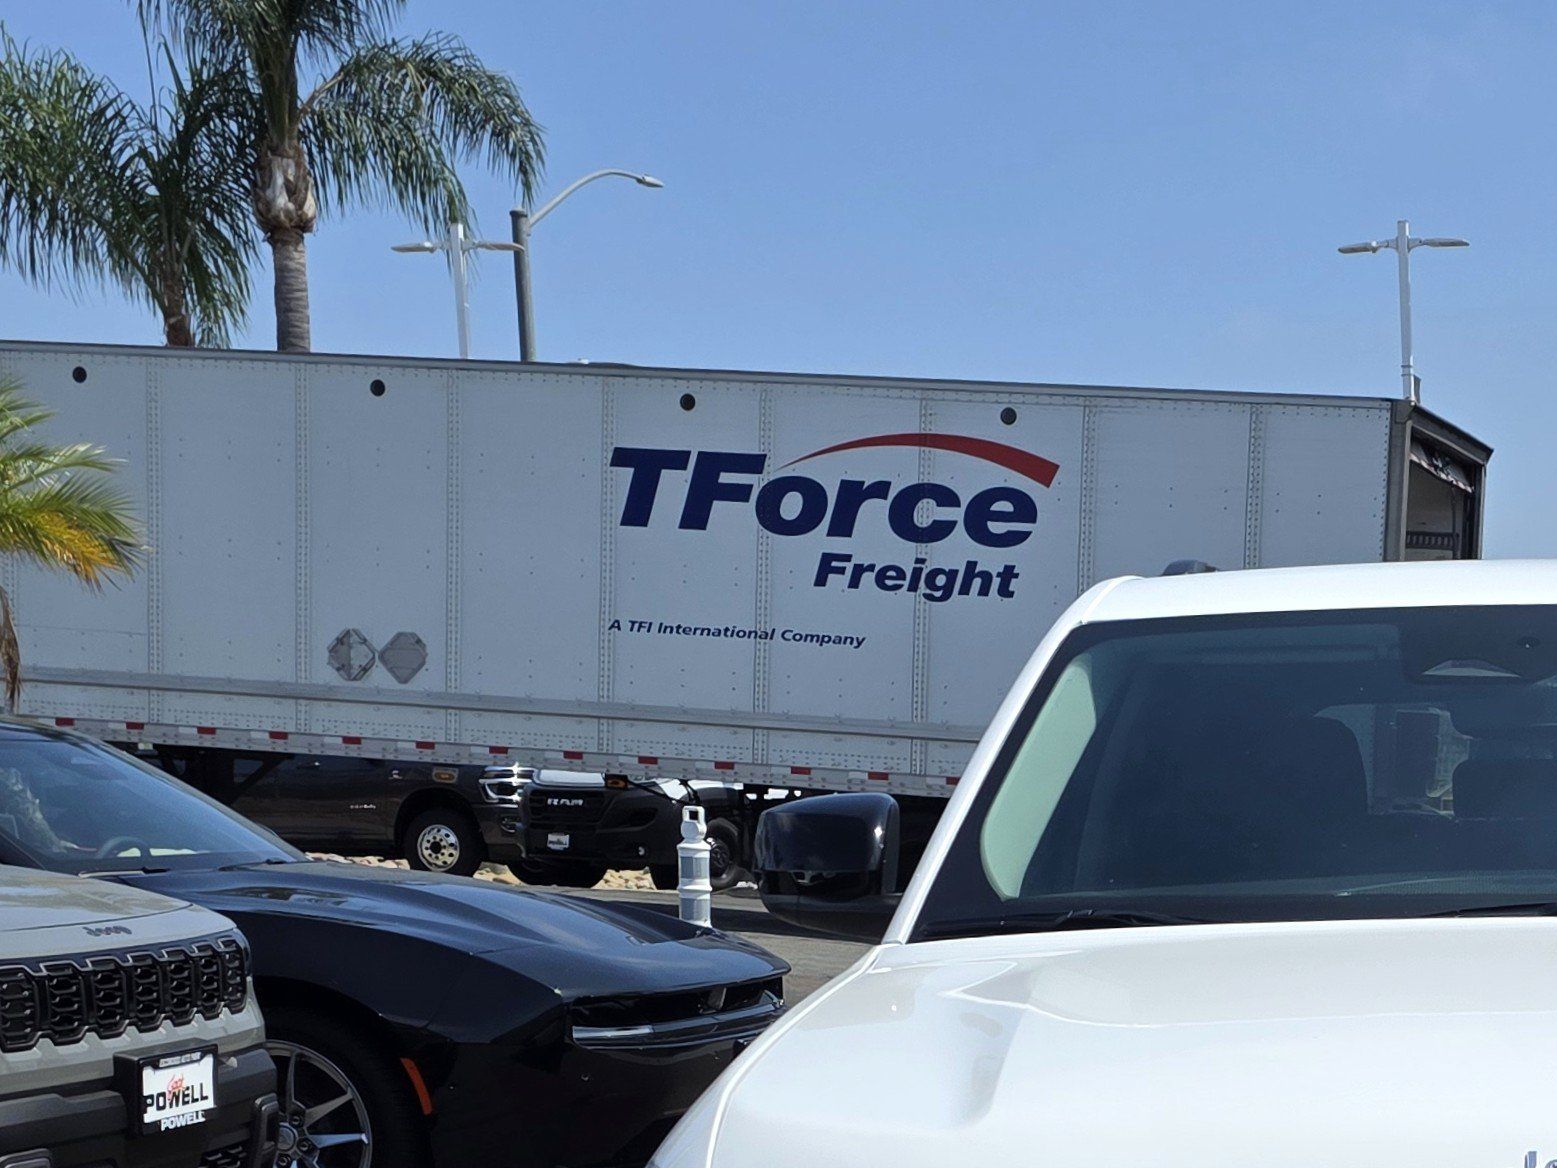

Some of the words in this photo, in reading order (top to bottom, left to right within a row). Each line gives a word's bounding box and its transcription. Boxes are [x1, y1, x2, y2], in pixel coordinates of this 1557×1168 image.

[609, 446, 1038, 548] TForce
[813, 552, 1020, 602] Freight
[608, 619, 622, 631] A
[628, 620, 653, 633] TFI
[657, 622, 776, 641] International
[780, 629, 866, 649] Company
[547, 798, 584, 806] RAM
[142, 1082, 209, 1113] POWELL
[160, 1110, 206, 1131] POWELL
